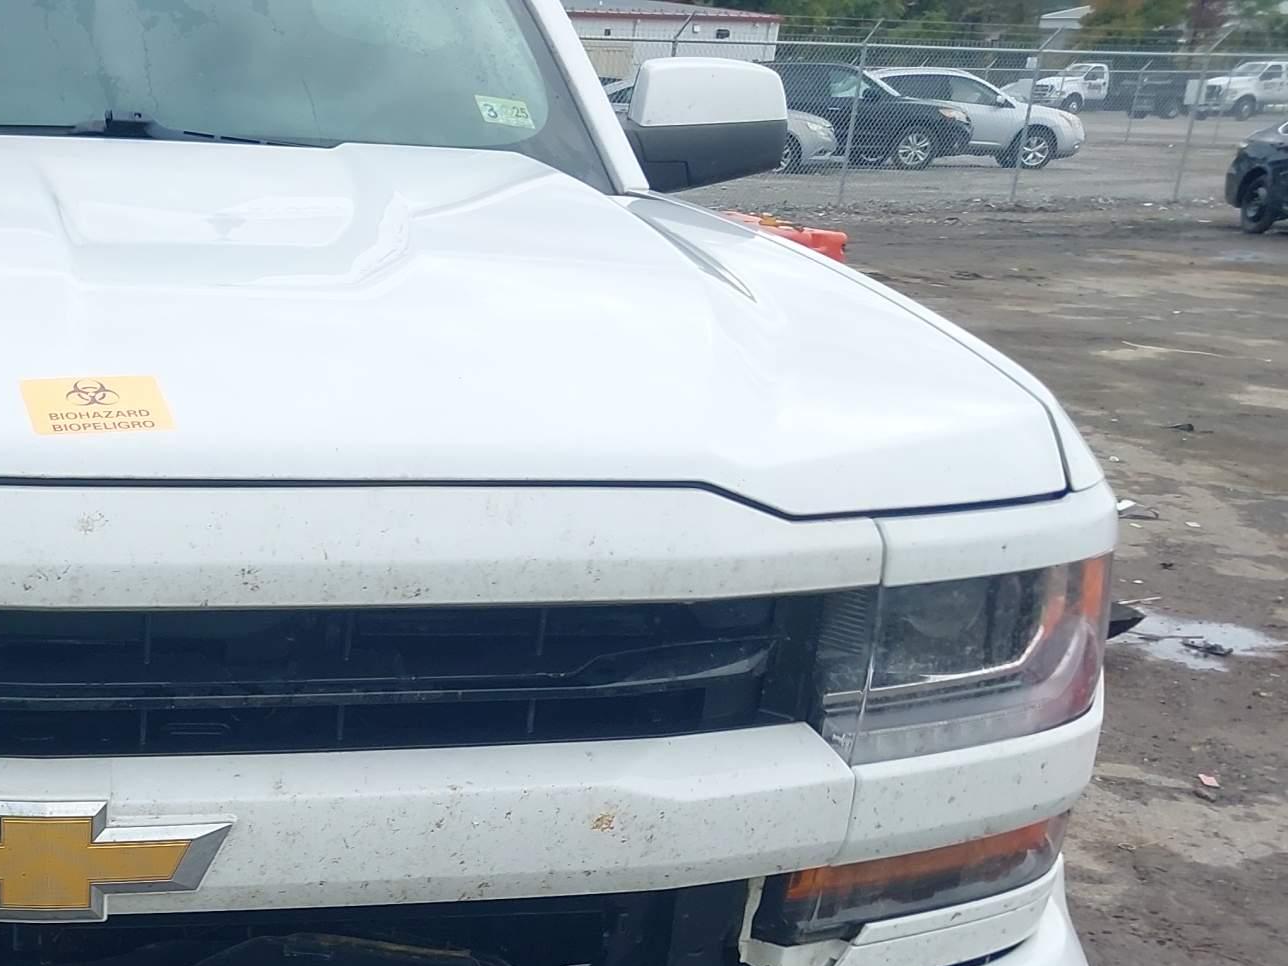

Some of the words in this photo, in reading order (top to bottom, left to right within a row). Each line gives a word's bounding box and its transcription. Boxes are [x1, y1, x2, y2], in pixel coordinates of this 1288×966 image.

[483, 103, 498, 119] 3
[512, 106, 529, 119] 25
[48, 409, 151, 421] BIOHAZARD
[52, 420, 156, 432] BIOPELIGRO
